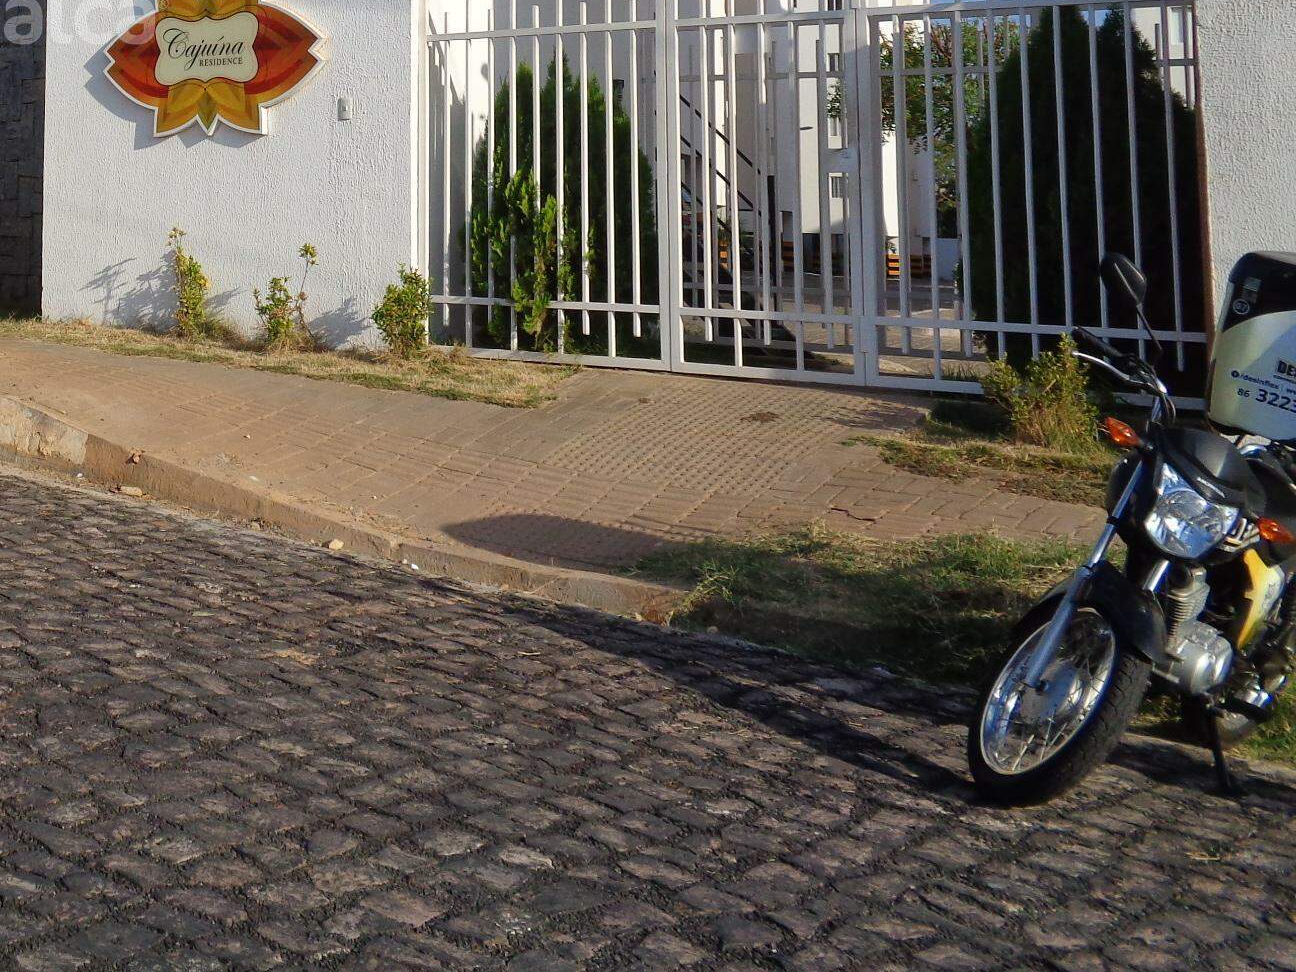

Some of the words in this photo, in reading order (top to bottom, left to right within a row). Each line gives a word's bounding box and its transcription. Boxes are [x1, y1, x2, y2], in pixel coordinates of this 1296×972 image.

[163, 28, 243, 70] Cajuína
[199, 57, 243, 67] RESIDENCE
[1237, 388, 1250, 398] 86
